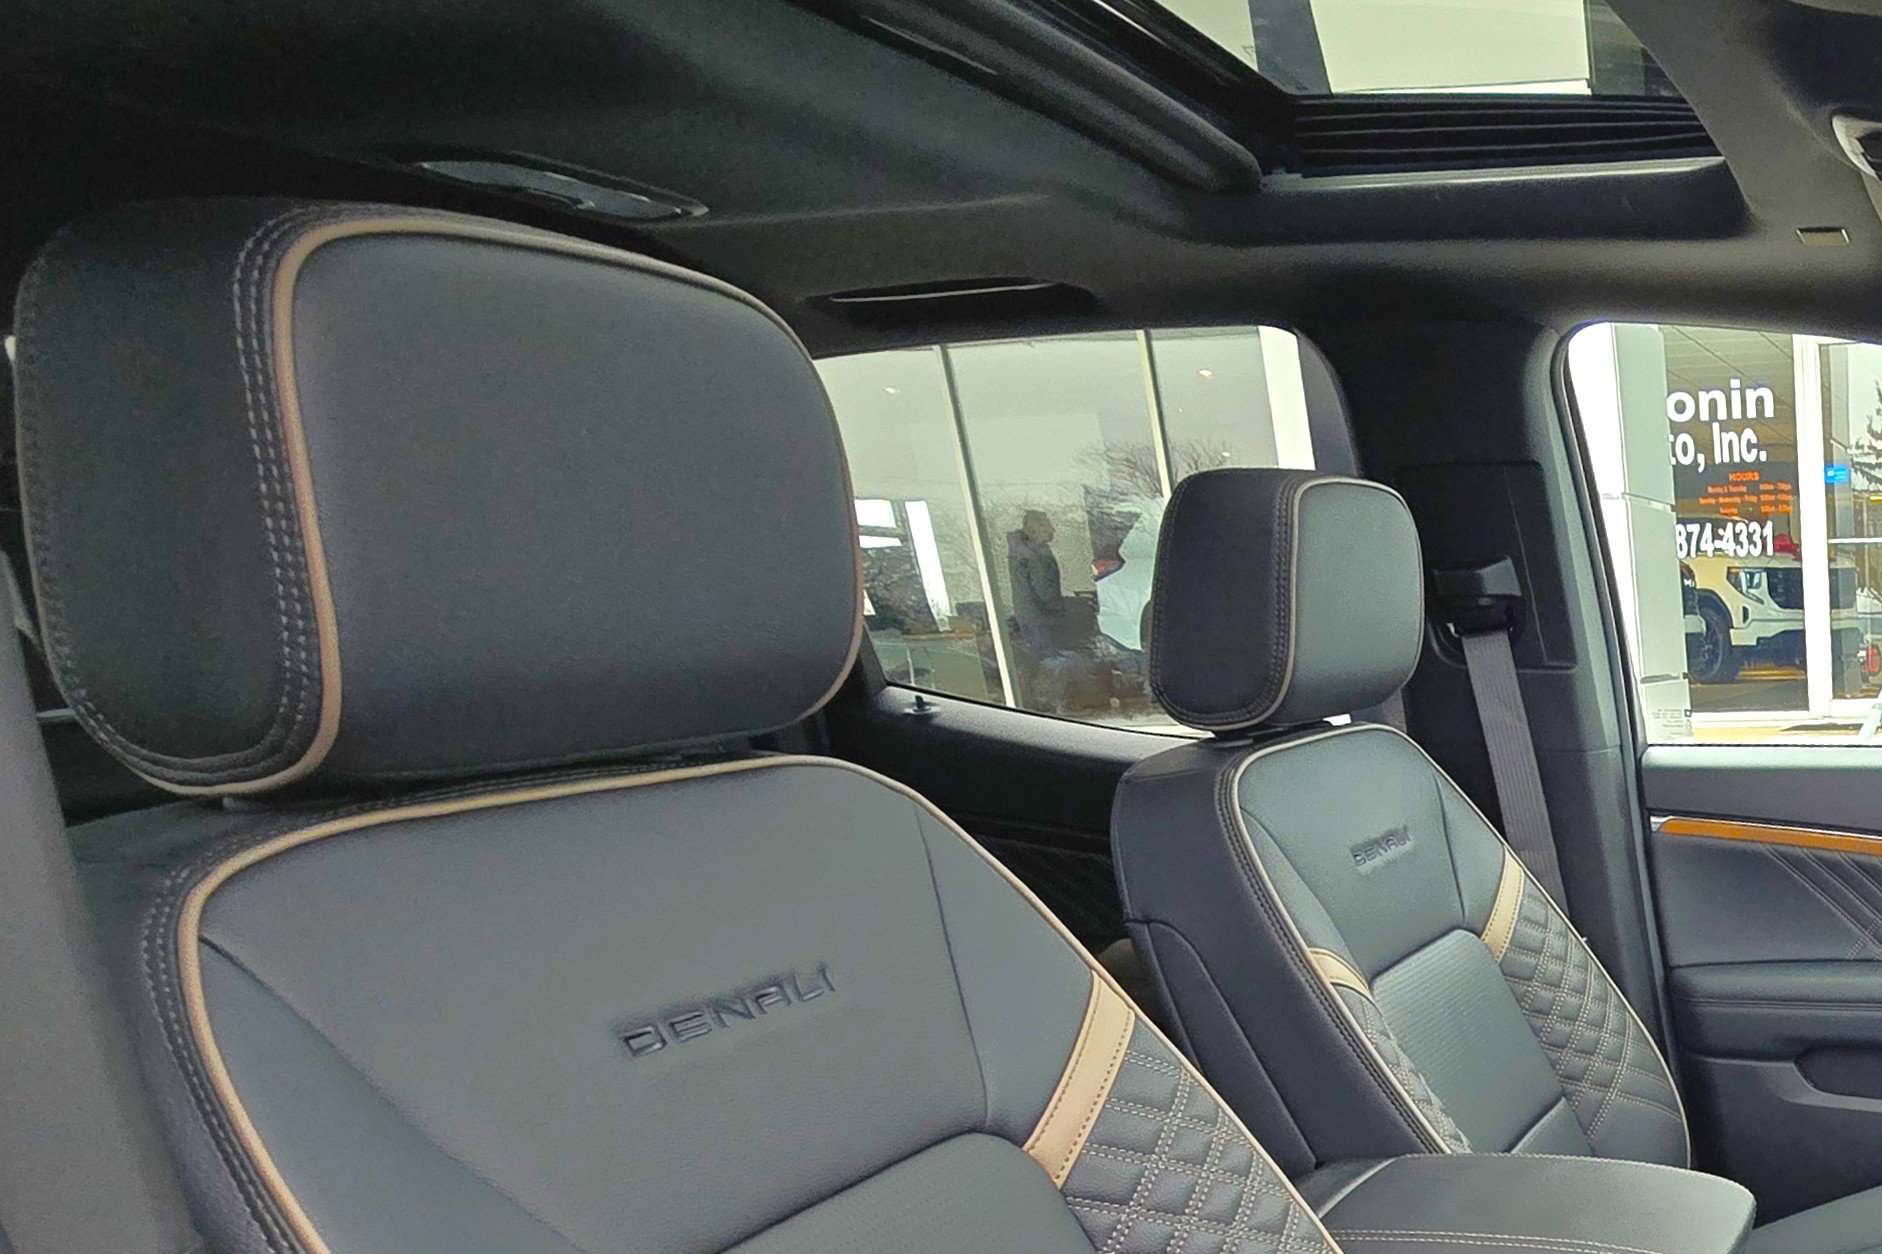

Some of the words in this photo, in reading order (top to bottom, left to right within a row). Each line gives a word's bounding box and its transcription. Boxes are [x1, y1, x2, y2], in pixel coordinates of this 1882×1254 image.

[1667, 378, 1774, 422] onin
[1712, 421, 1767, 465] Inc.
[1675, 520, 1774, 559] 874-4331
[1350, 824, 1411, 867] DENALI
[618, 960, 836, 1056] DENALI
